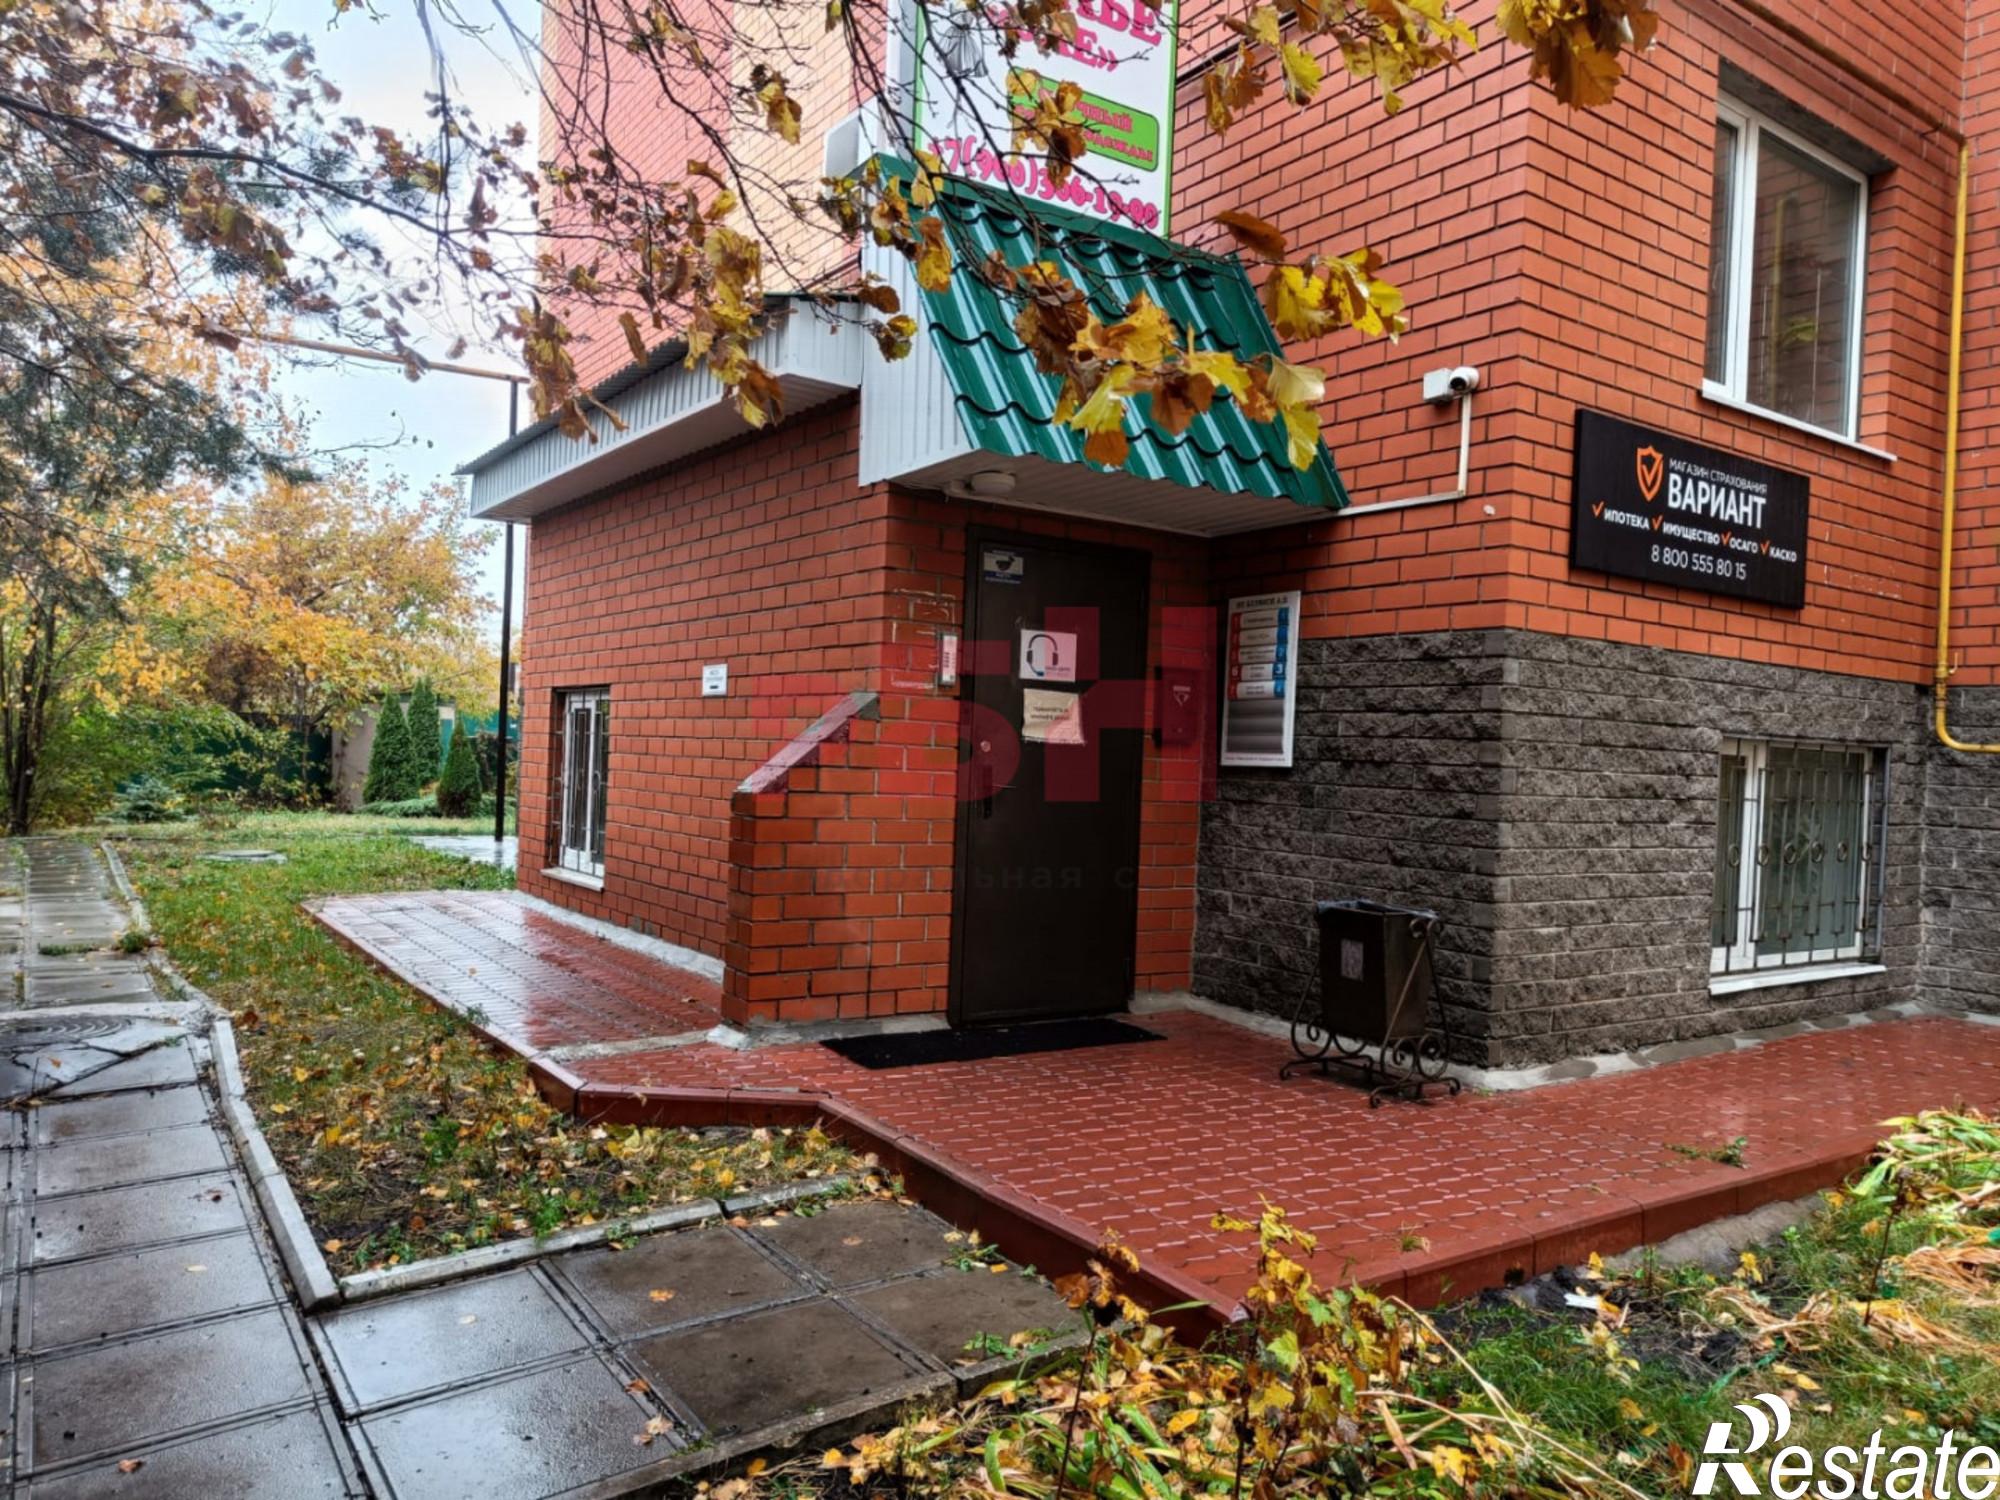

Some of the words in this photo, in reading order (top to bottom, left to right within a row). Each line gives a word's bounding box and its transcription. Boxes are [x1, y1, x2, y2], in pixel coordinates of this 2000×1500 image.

[1669, 458, 1709, 480] МАГАЗИН
[1710, 469, 1768, 495] СТРАХОВАНИЯ
[1668, 472, 1766, 529] ВАРИАНТ
[1604, 508, 1650, 530] ИПОТЕКА
[1663, 521, 1720, 545] ИМУЩЕСТВО
[1729, 538, 1758, 554] ОСАГО
[1769, 546, 1797, 562] КАСКО
[1651, 544, 1660, 563] 8
[1663, 547, 1688, 569] 800
[1691, 553, 1714, 575] 555
[1716, 558, 1732, 577] 80
[1735, 562, 1747, 580] 15
